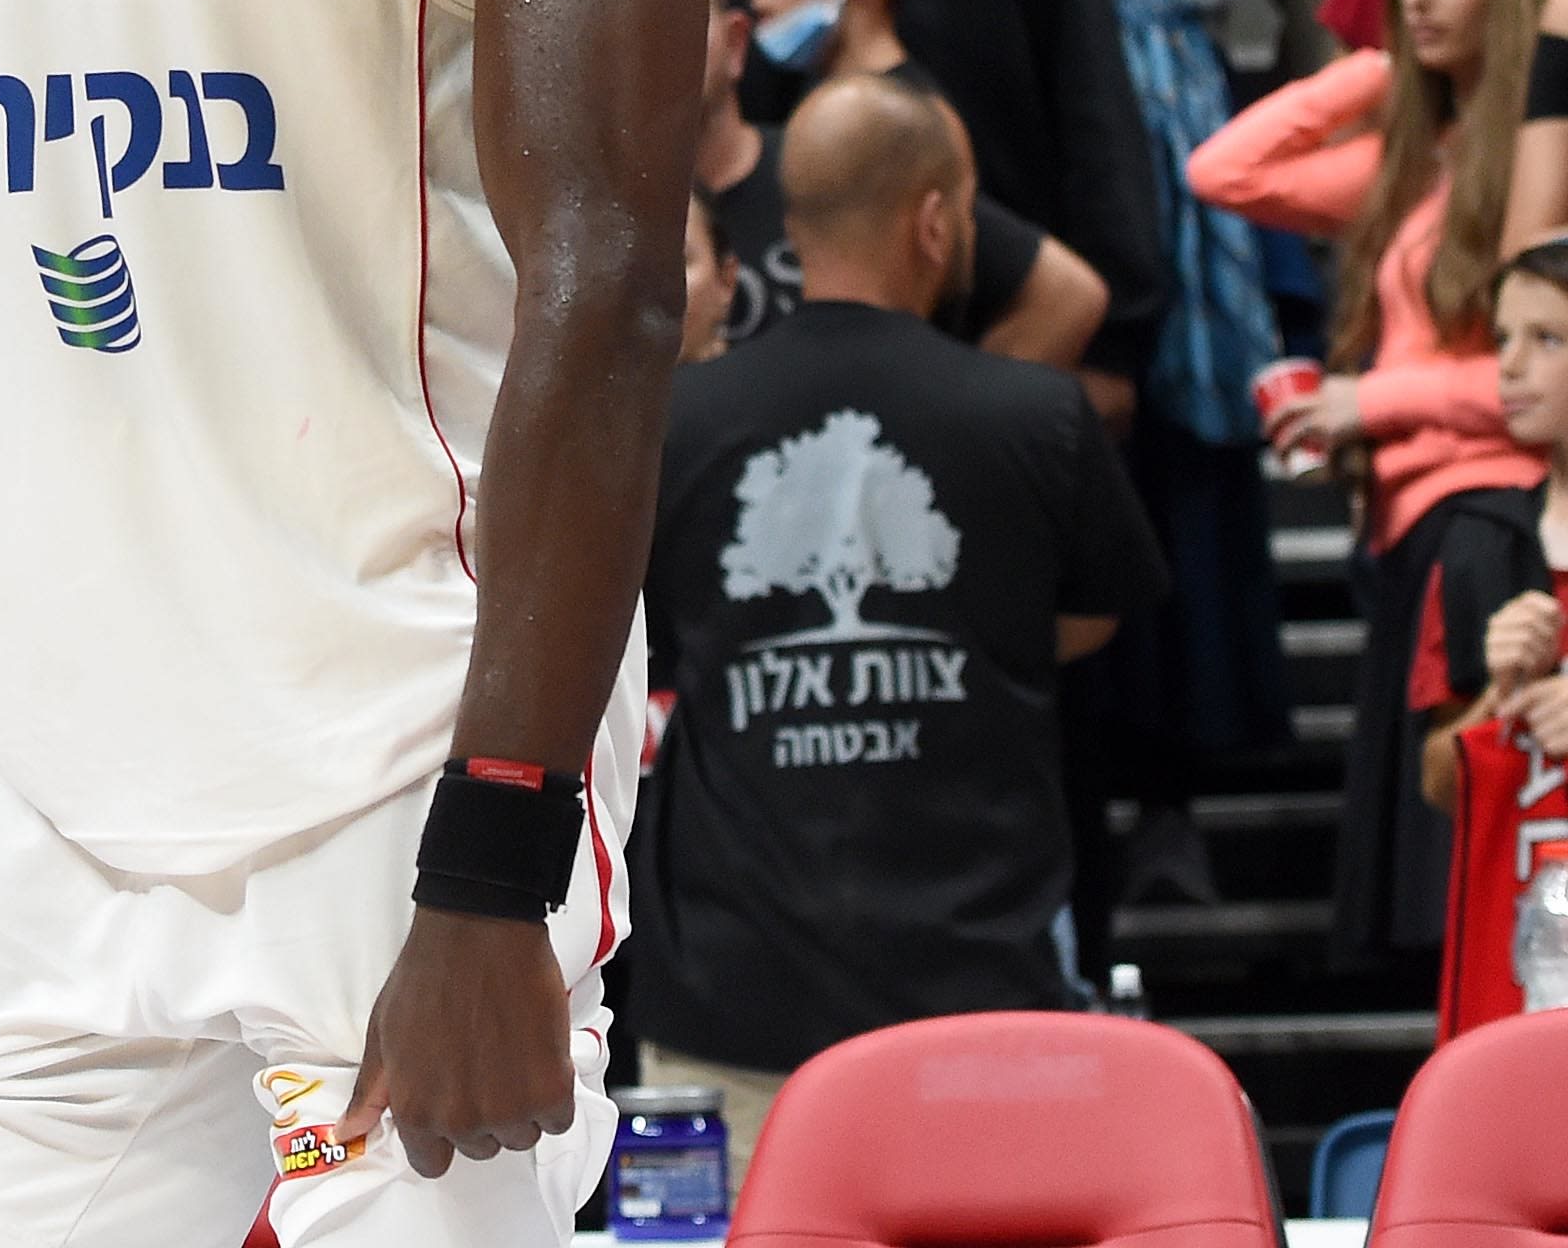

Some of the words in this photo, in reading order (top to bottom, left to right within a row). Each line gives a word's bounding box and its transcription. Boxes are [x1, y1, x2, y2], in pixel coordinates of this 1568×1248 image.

[727, 649, 835, 732] אלון
[847, 649, 968, 706] צוות
[774, 718, 920, 768] אבטחה
[290, 1130, 316, 1154] ליגת
[320, 1142, 346, 1164] סל
